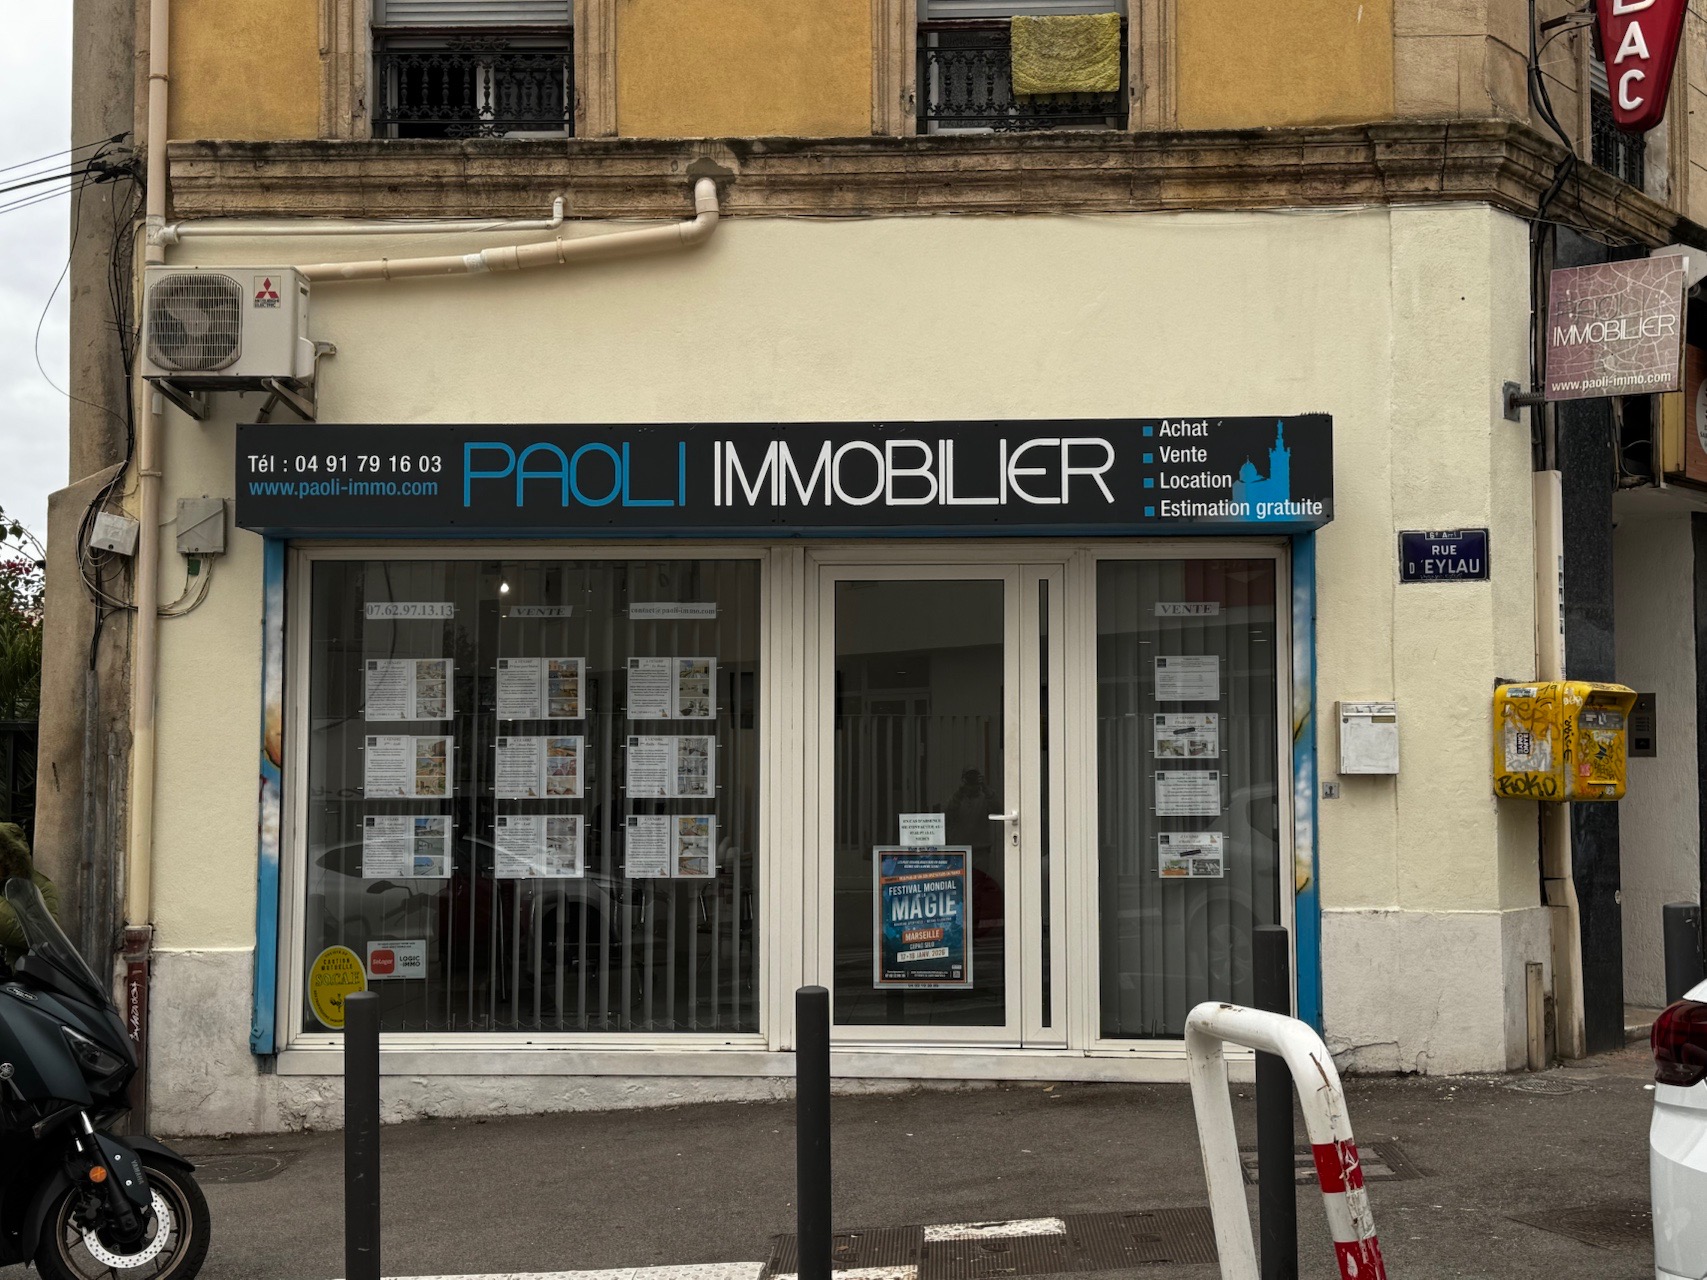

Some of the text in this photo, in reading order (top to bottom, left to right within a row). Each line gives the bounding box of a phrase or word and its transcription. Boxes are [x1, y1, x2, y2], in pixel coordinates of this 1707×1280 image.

[1553, 314, 1676, 347] IMMOBILIER
[1551, 372, 1671, 391] www.paoli-immo.com
[1159, 420, 1208, 437] Achat
[1159, 446, 1207, 463] Vente
[248, 454, 274, 473] Tél
[295, 455, 318, 473] 04
[326, 455, 347, 473] 91
[357, 455, 380, 473] 79
[389, 455, 411, 473] 16
[418, 455, 442, 473] 03
[464, 437, 1116, 507] PAOLI IMMOBILIER
[249, 478, 438, 499] www.paoli-immo.com
[1160, 471, 1232, 489] Location
[1160, 498, 1323, 520] Estimation gratuite
[1431, 545, 1457, 555] RUE
[366, 604, 453, 616] 07.62.97.13.13
[516, 607, 566, 616] VENTE
[1161, 604, 1212, 614] VENTE
[888, 884, 921, 896] FESTIVAL
[923, 880, 957, 892] MONDIAL
[891, 891, 957, 921] MAGIE
[905, 930, 940, 941] MARSEILLE
